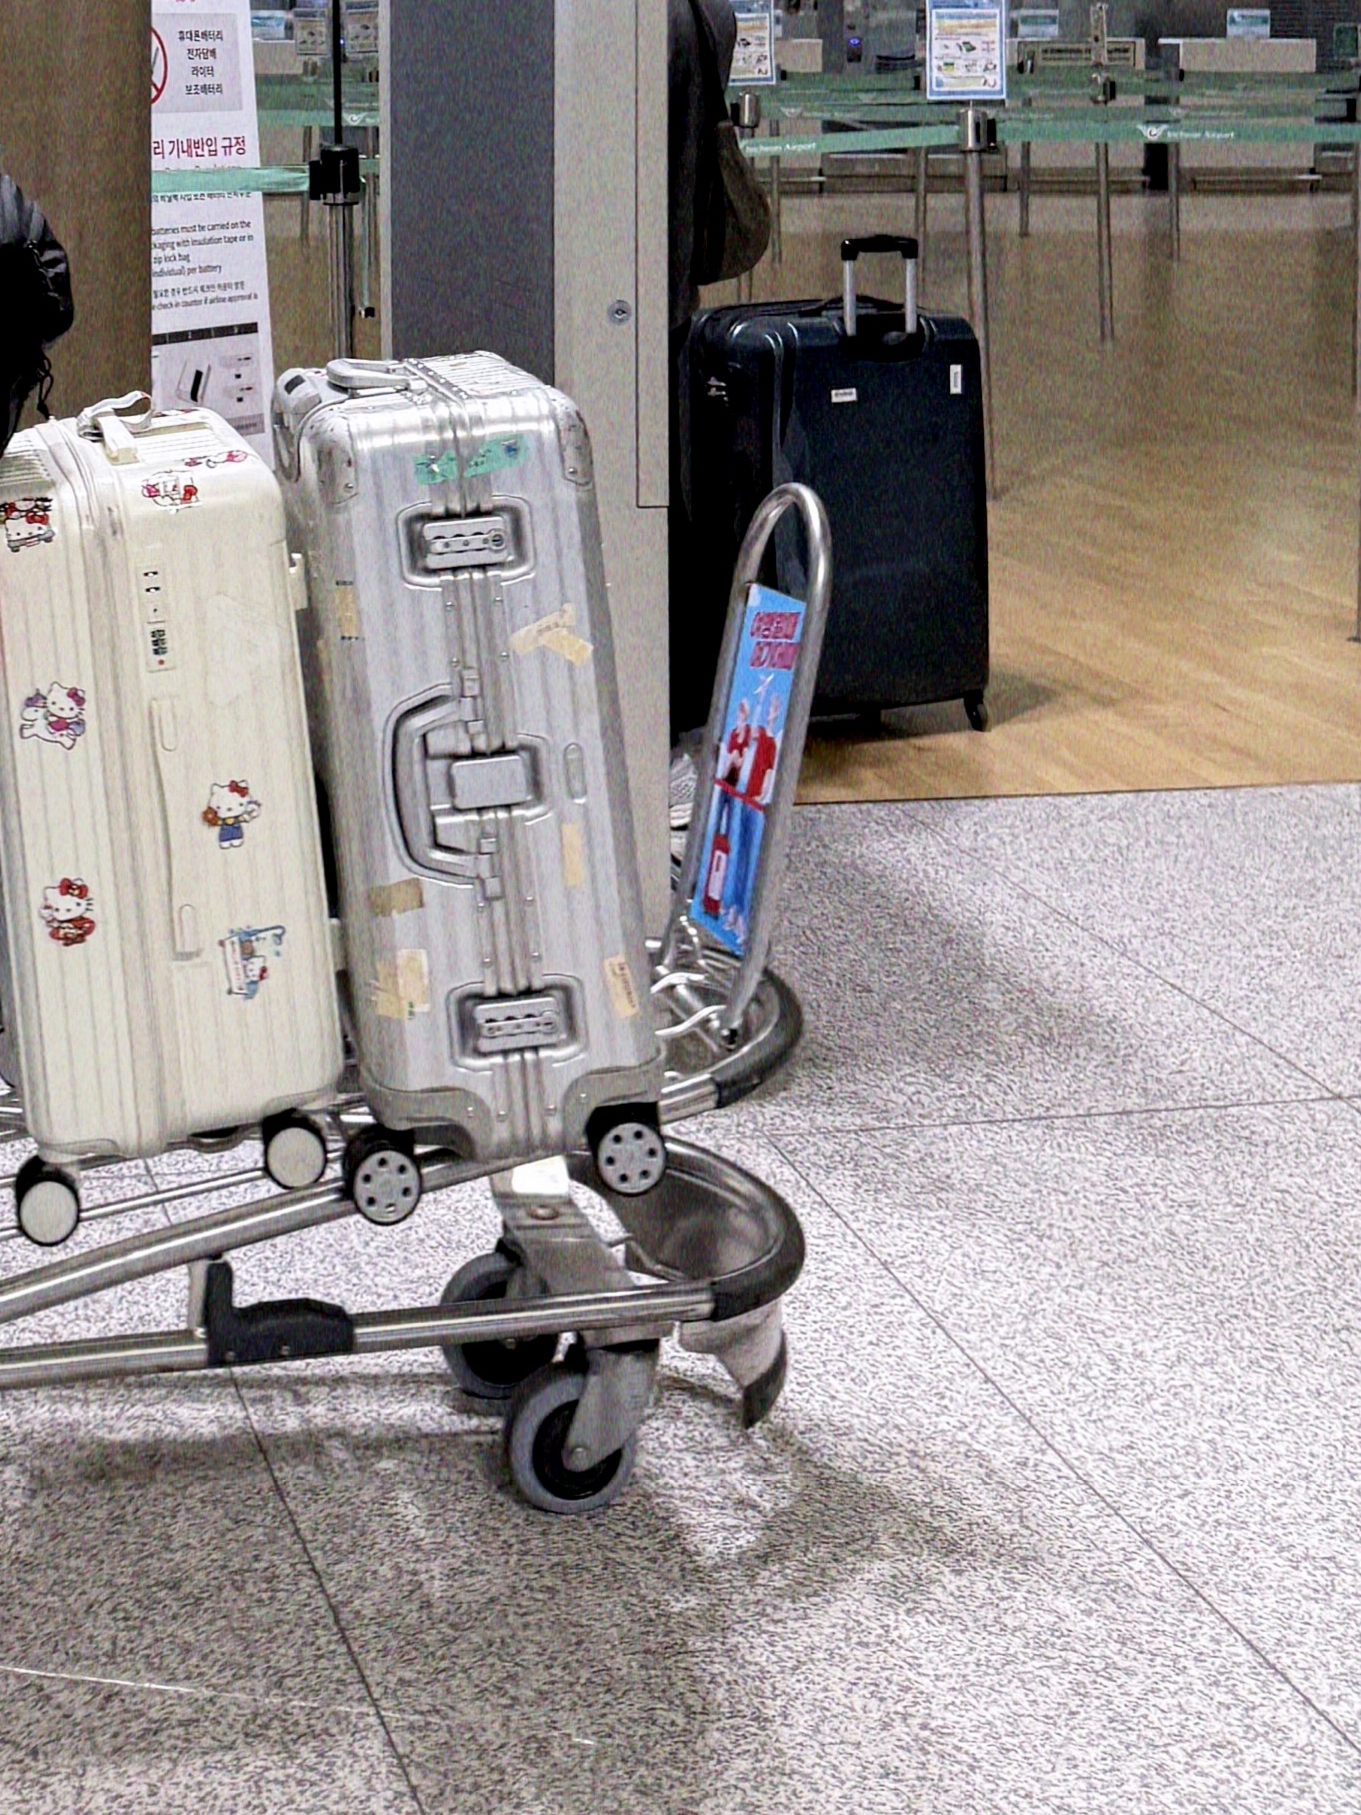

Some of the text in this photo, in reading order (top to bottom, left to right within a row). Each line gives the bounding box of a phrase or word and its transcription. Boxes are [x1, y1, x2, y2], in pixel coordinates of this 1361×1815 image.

[191, 66, 214, 78] 라이터
[168, 137, 218, 159] 기내반입
[221, 135, 247, 157] 규정
